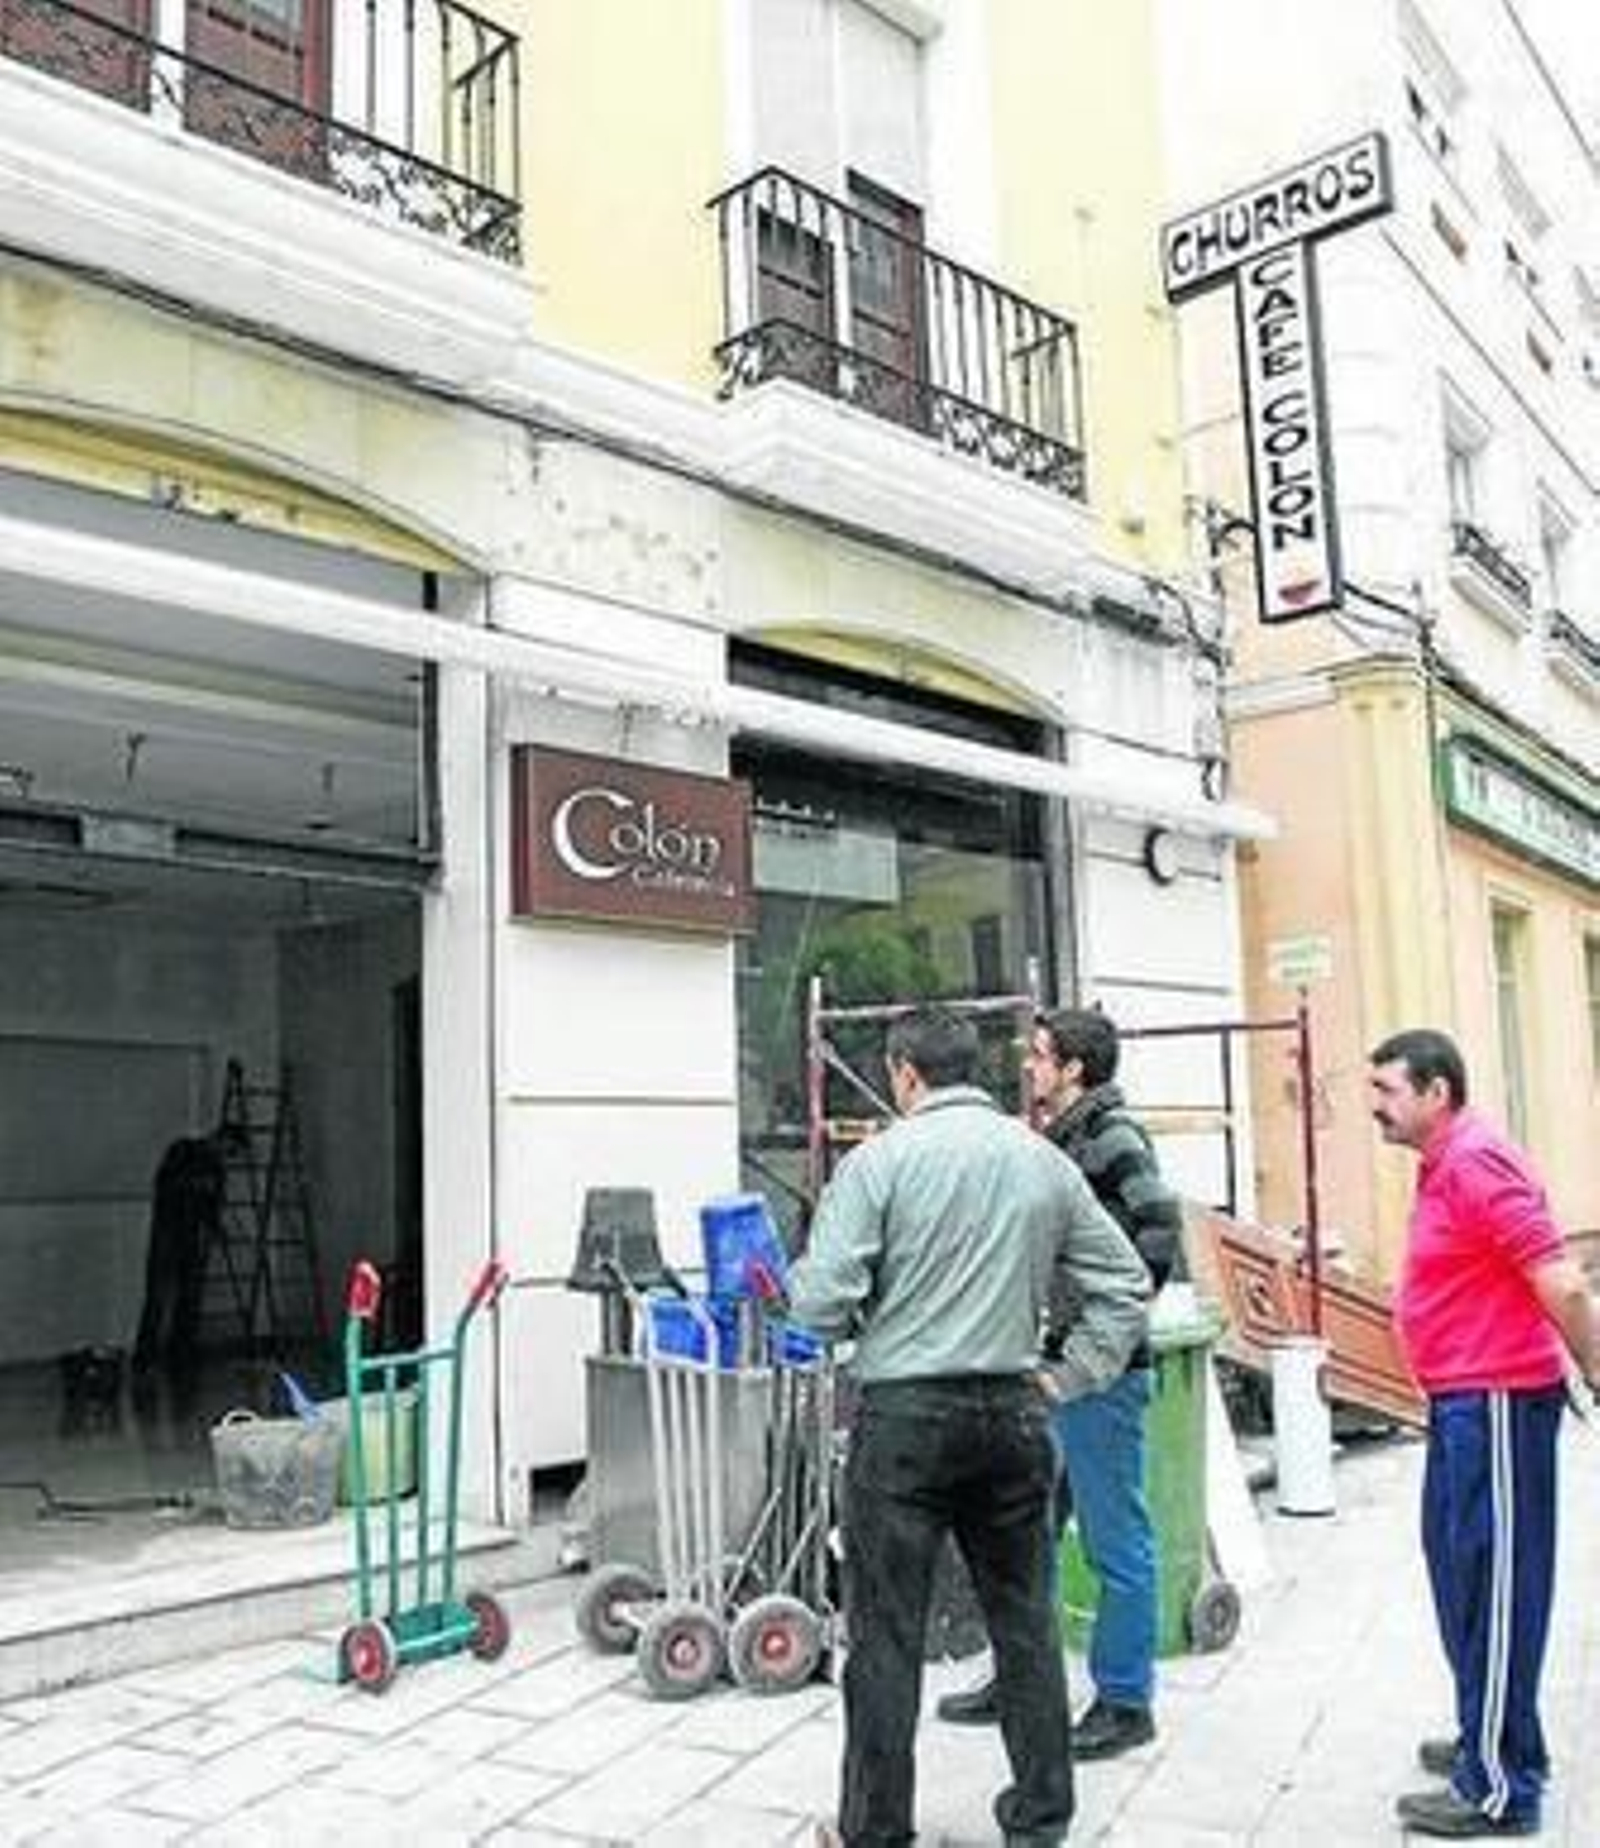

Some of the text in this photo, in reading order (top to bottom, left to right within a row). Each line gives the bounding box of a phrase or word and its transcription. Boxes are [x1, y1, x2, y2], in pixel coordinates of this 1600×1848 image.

[1169, 151, 1375, 275] CHURROS
[1251, 252, 1315, 551] CAFE COLON
[553, 788, 721, 879] Colón
